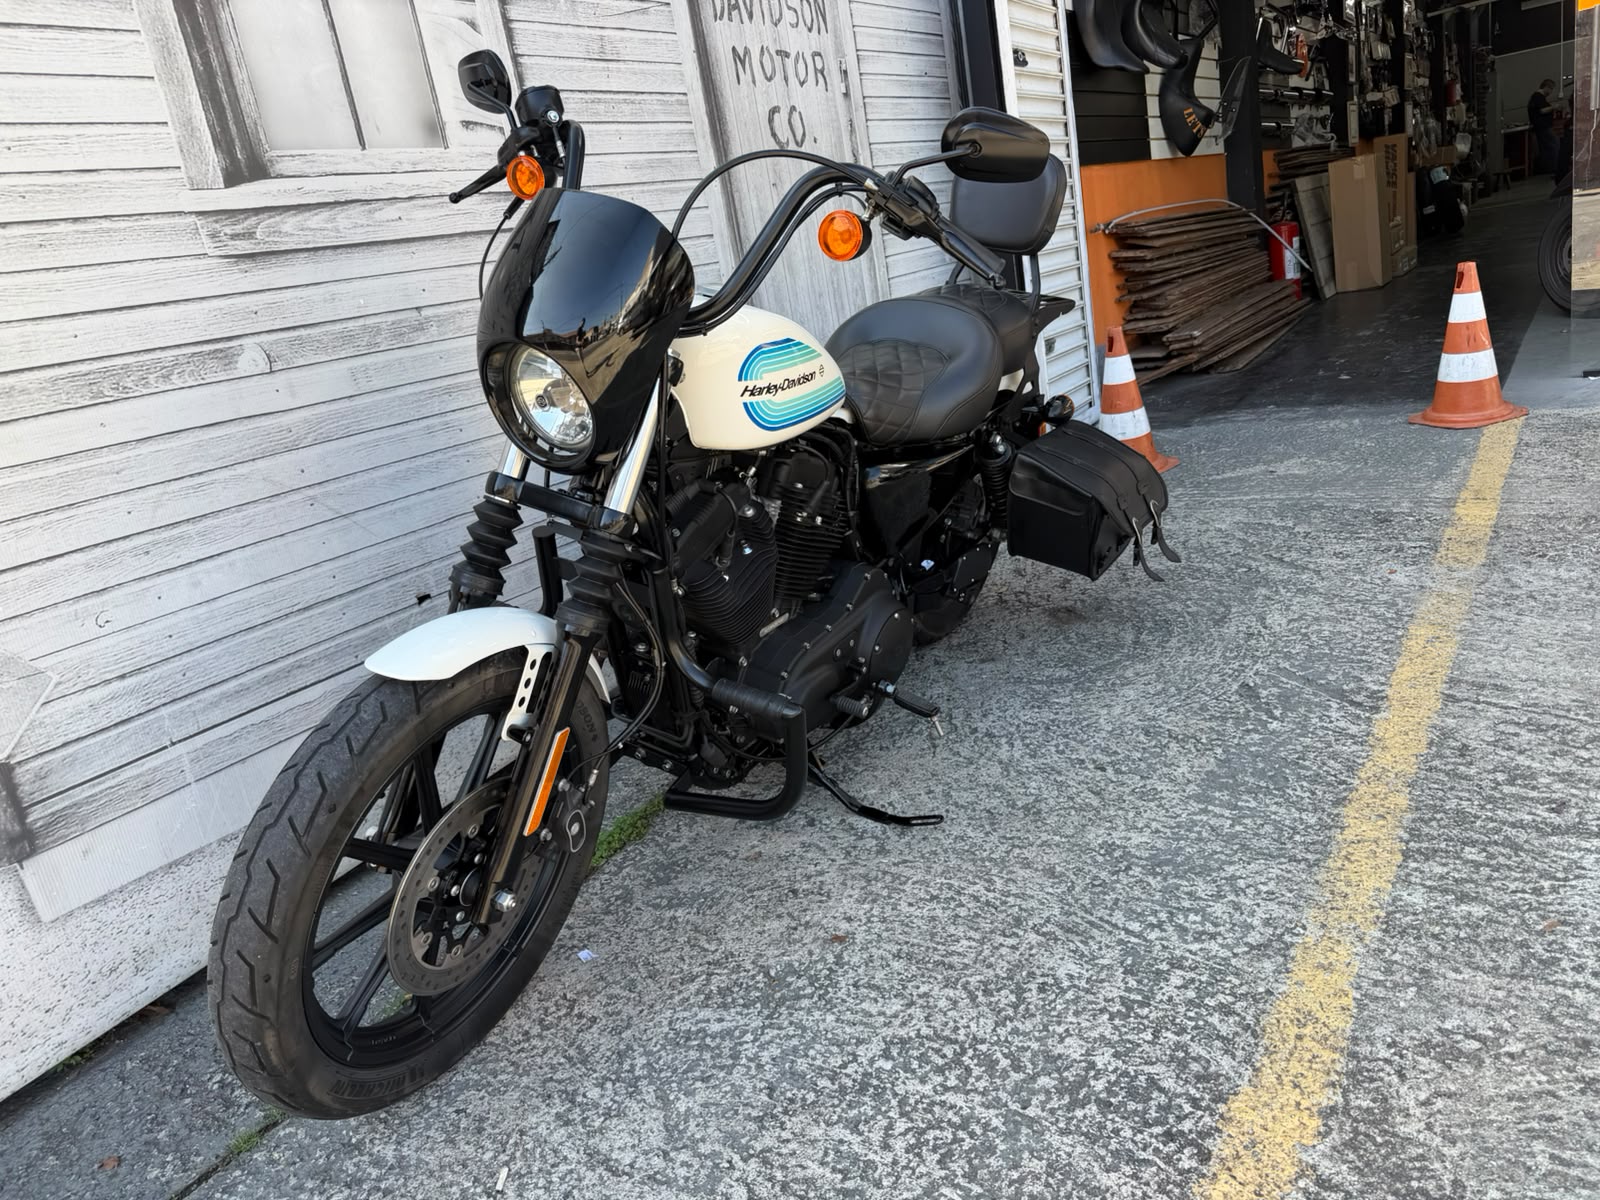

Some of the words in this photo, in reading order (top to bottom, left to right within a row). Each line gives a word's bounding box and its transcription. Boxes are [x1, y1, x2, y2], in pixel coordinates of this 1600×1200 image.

[711, 0, 829, 35] DAVIDSON
[731, 45, 829, 92] MOTOR
[767, 105, 819, 150] CO.
[740, 371, 816, 397] Harley-Davidson
